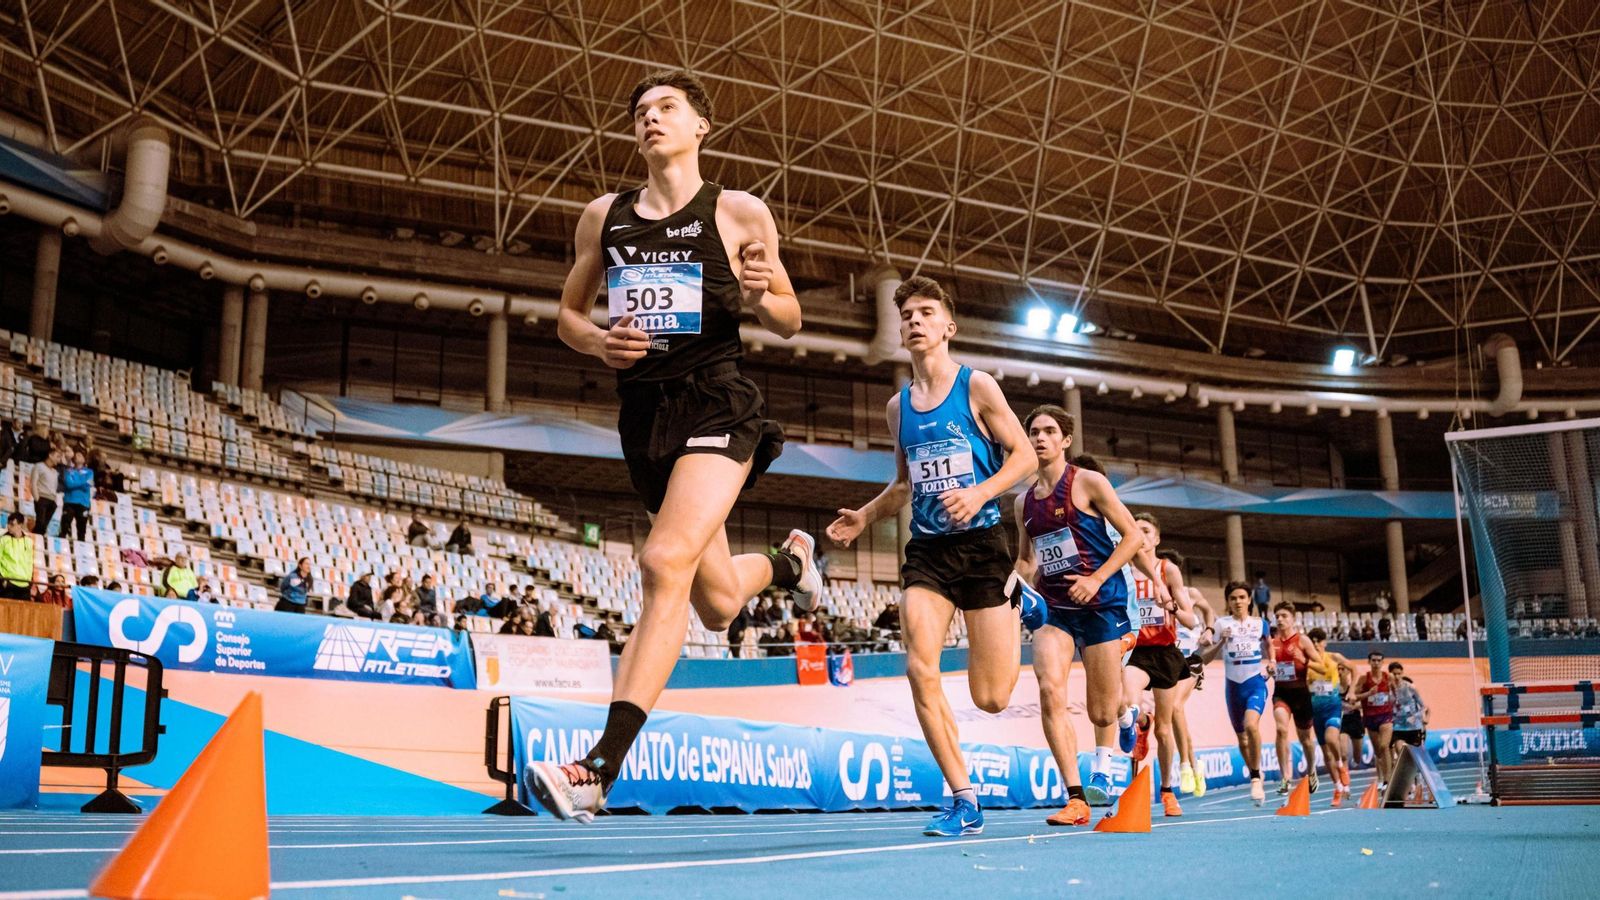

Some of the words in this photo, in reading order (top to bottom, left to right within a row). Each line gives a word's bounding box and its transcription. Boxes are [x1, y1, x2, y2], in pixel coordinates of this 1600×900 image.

[640, 251, 693, 263] VICKY
[626, 287, 674, 312] 503
[629, 314, 679, 331] oma
[921, 458, 951, 479] 511
[921, 477, 960, 494] Joma
[1040, 545, 1063, 563] 230
[216, 631, 250, 649] Consejo
[215, 645, 252, 660] Superior
[215, 656, 227, 666] de
[228, 658, 266, 671] Deportes
[1438, 732, 1488, 758] Jom
[1519, 729, 1587, 755] Joma
[526, 727, 675, 781] CAMPNATO
[678, 732, 700, 781] de
[701, 732, 767, 786] ESPAÑA
[767, 743, 812, 790] Sub18
